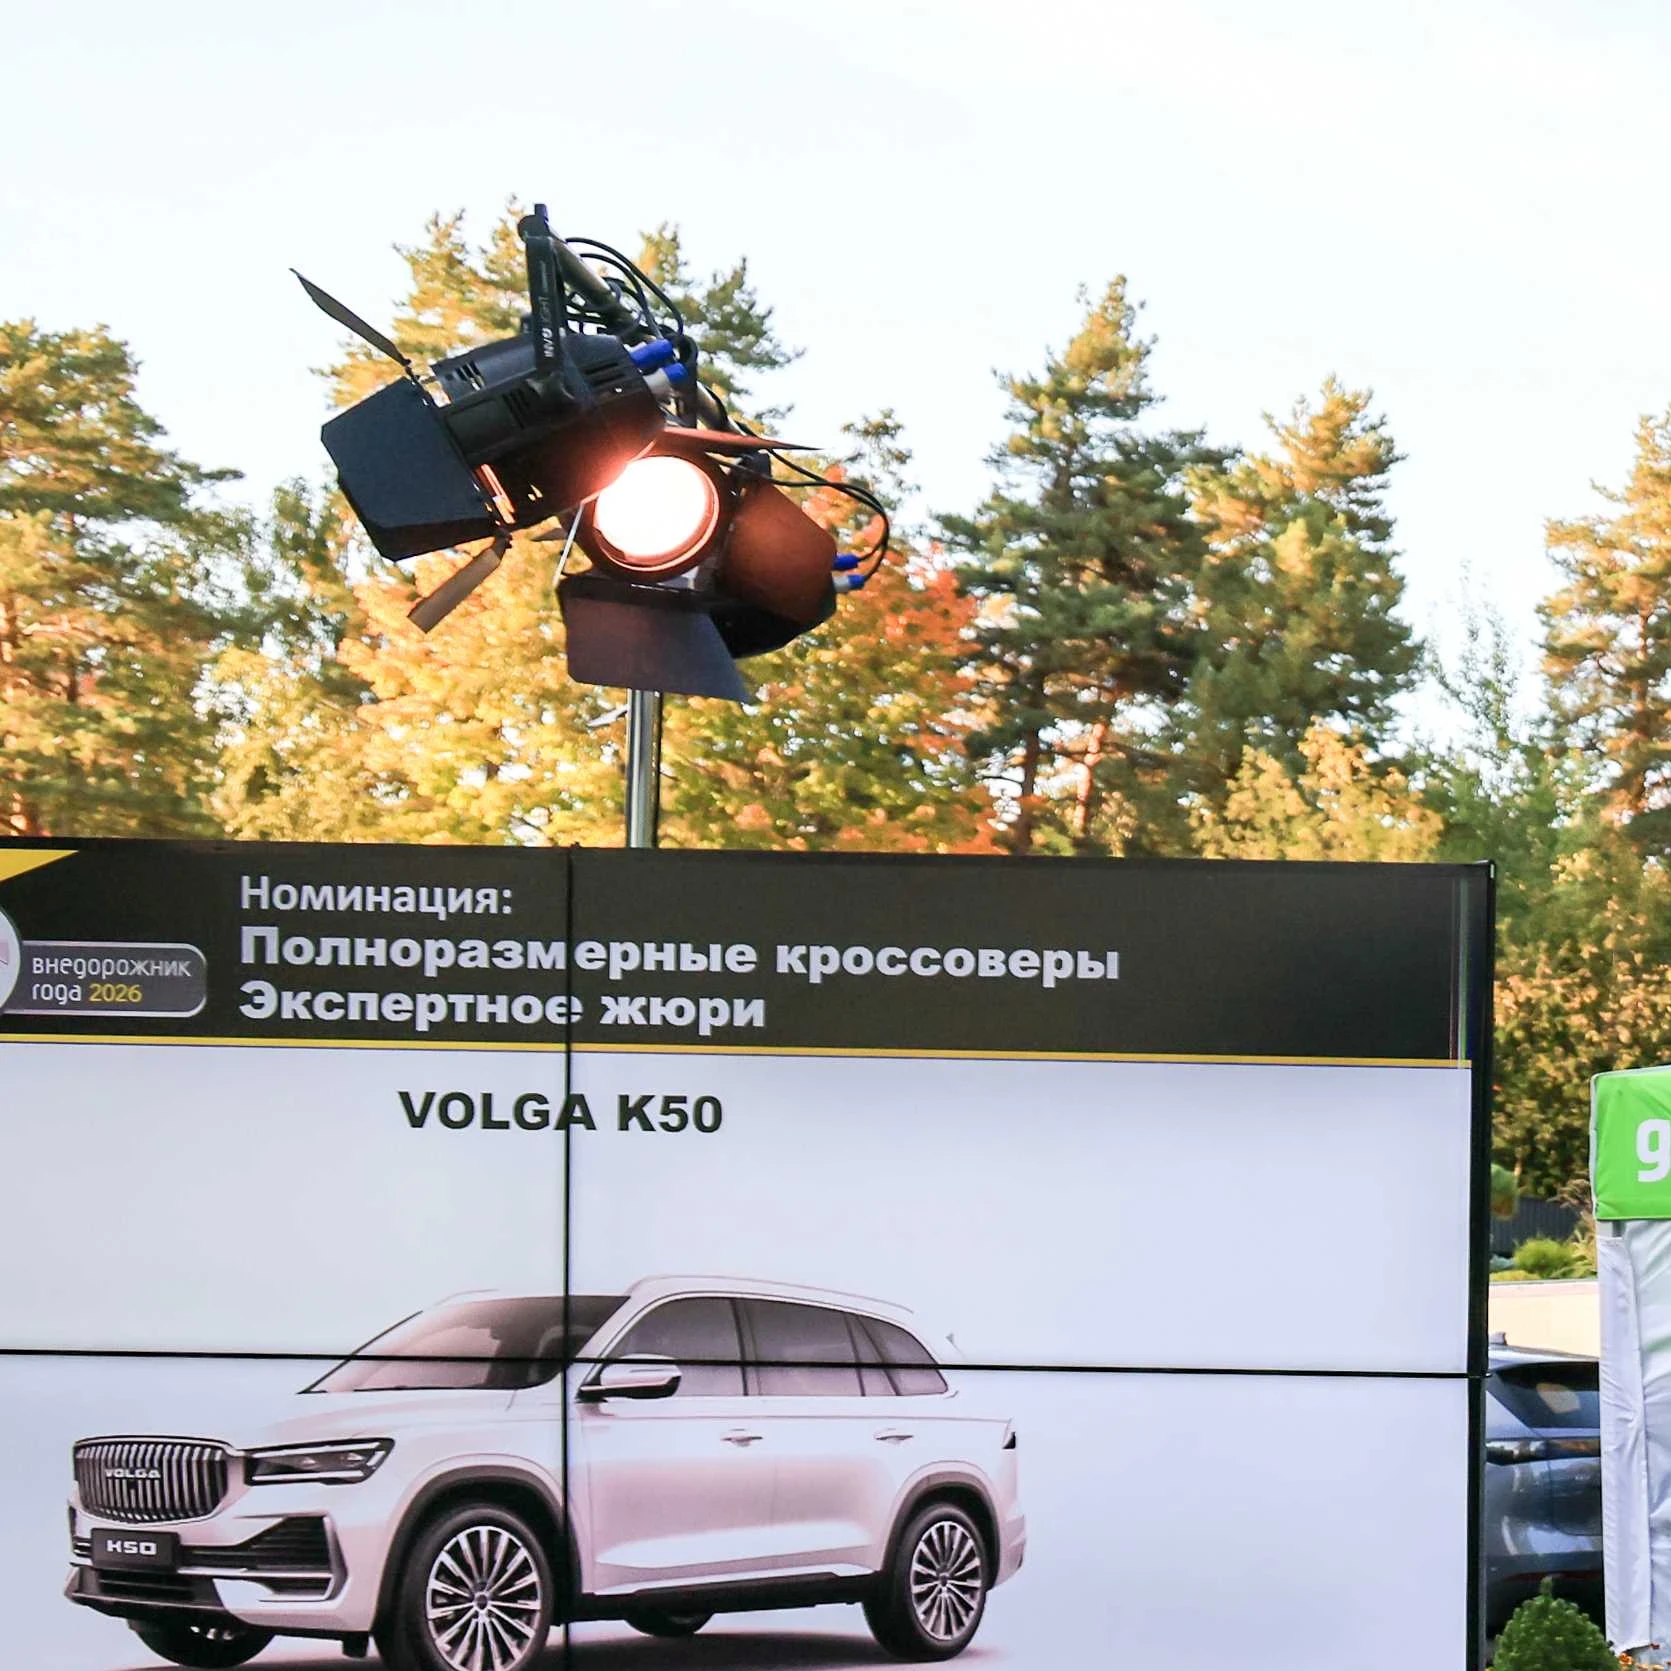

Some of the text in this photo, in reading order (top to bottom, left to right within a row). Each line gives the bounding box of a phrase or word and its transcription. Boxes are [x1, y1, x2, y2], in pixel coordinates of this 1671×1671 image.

[239, 875, 513, 919] Номинация:
[240, 926, 1119, 988] Полноразмерные кроссоверы
[31, 982, 142, 1003] года 2026
[239, 980, 766, 1036] Экспертное жюри
[399, 1090, 723, 1133] VOLGA K50
